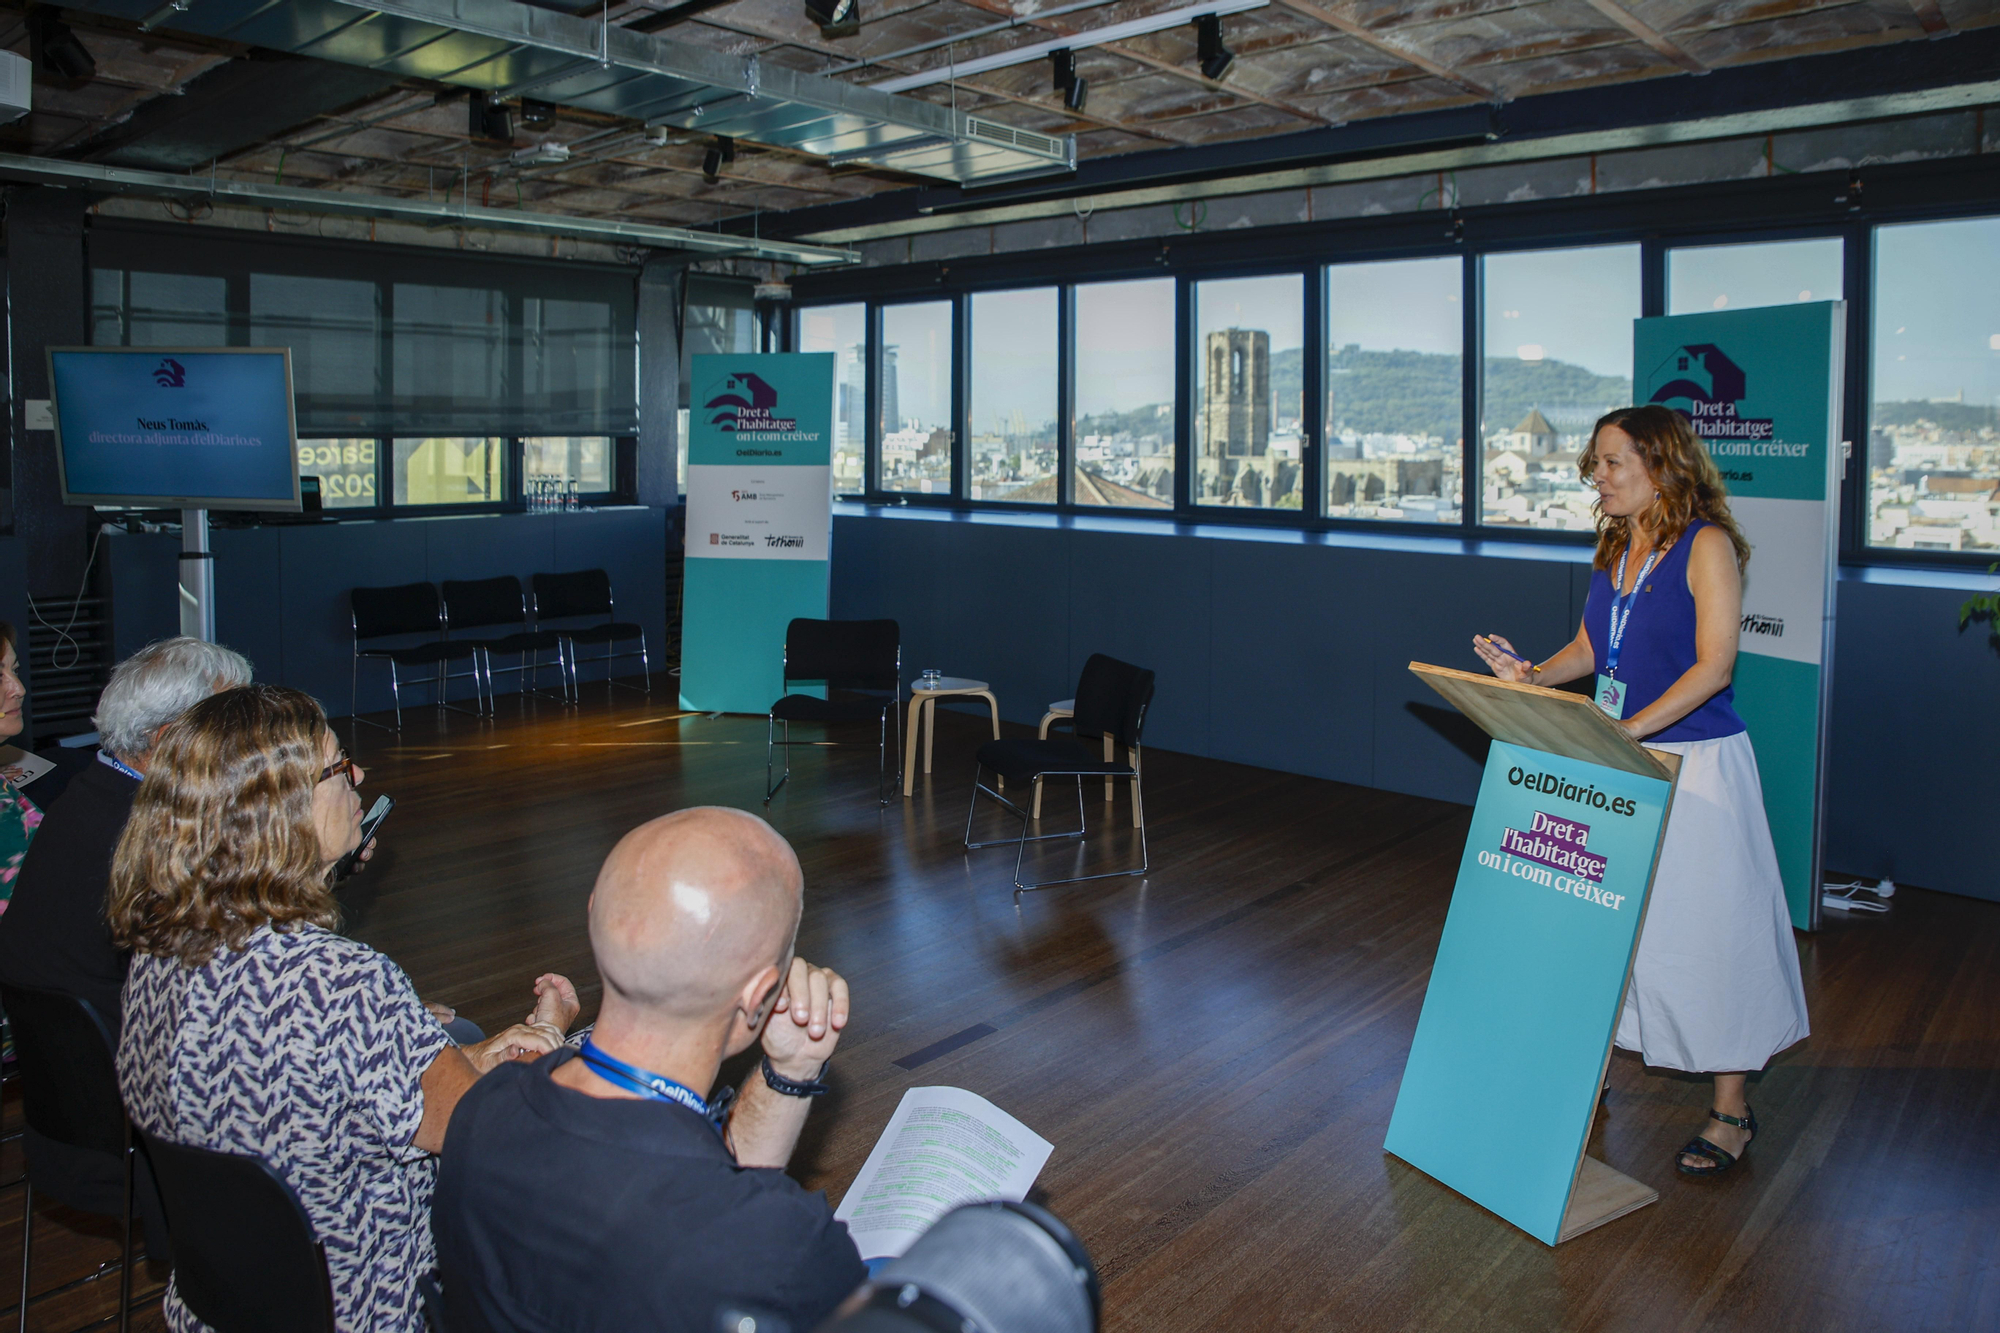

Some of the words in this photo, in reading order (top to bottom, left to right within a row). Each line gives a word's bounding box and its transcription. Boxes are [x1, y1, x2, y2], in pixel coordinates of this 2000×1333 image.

[738, 407, 761, 418] Dret
[763, 408, 769, 418] a
[1692, 400, 1724, 417] Dret
[1725, 403, 1735, 416] a
[138, 417, 166, 430] Neus
[737, 419, 796, 432] l'habitatge:
[1691, 419, 1773, 440] l'habitatge:
[89, 431, 142, 443] directora
[144, 432, 190, 446] adjunta
[736, 432, 751, 442] on
[757, 432, 780, 442] com
[782, 430, 820, 442] créixer
[1712, 439, 1717, 455] i
[1718, 442, 1751, 456] com
[1753, 439, 1810, 457] créixer
[1530, 811, 1575, 842] Dret
[1575, 829, 1588, 846] a
[1501, 827, 1606, 878] l'habitatge:
[1478, 850, 1502, 870] on
[1502, 853, 1511, 873] i
[1511, 861, 1552, 888] com
[1554, 875, 1625, 910] créixer
